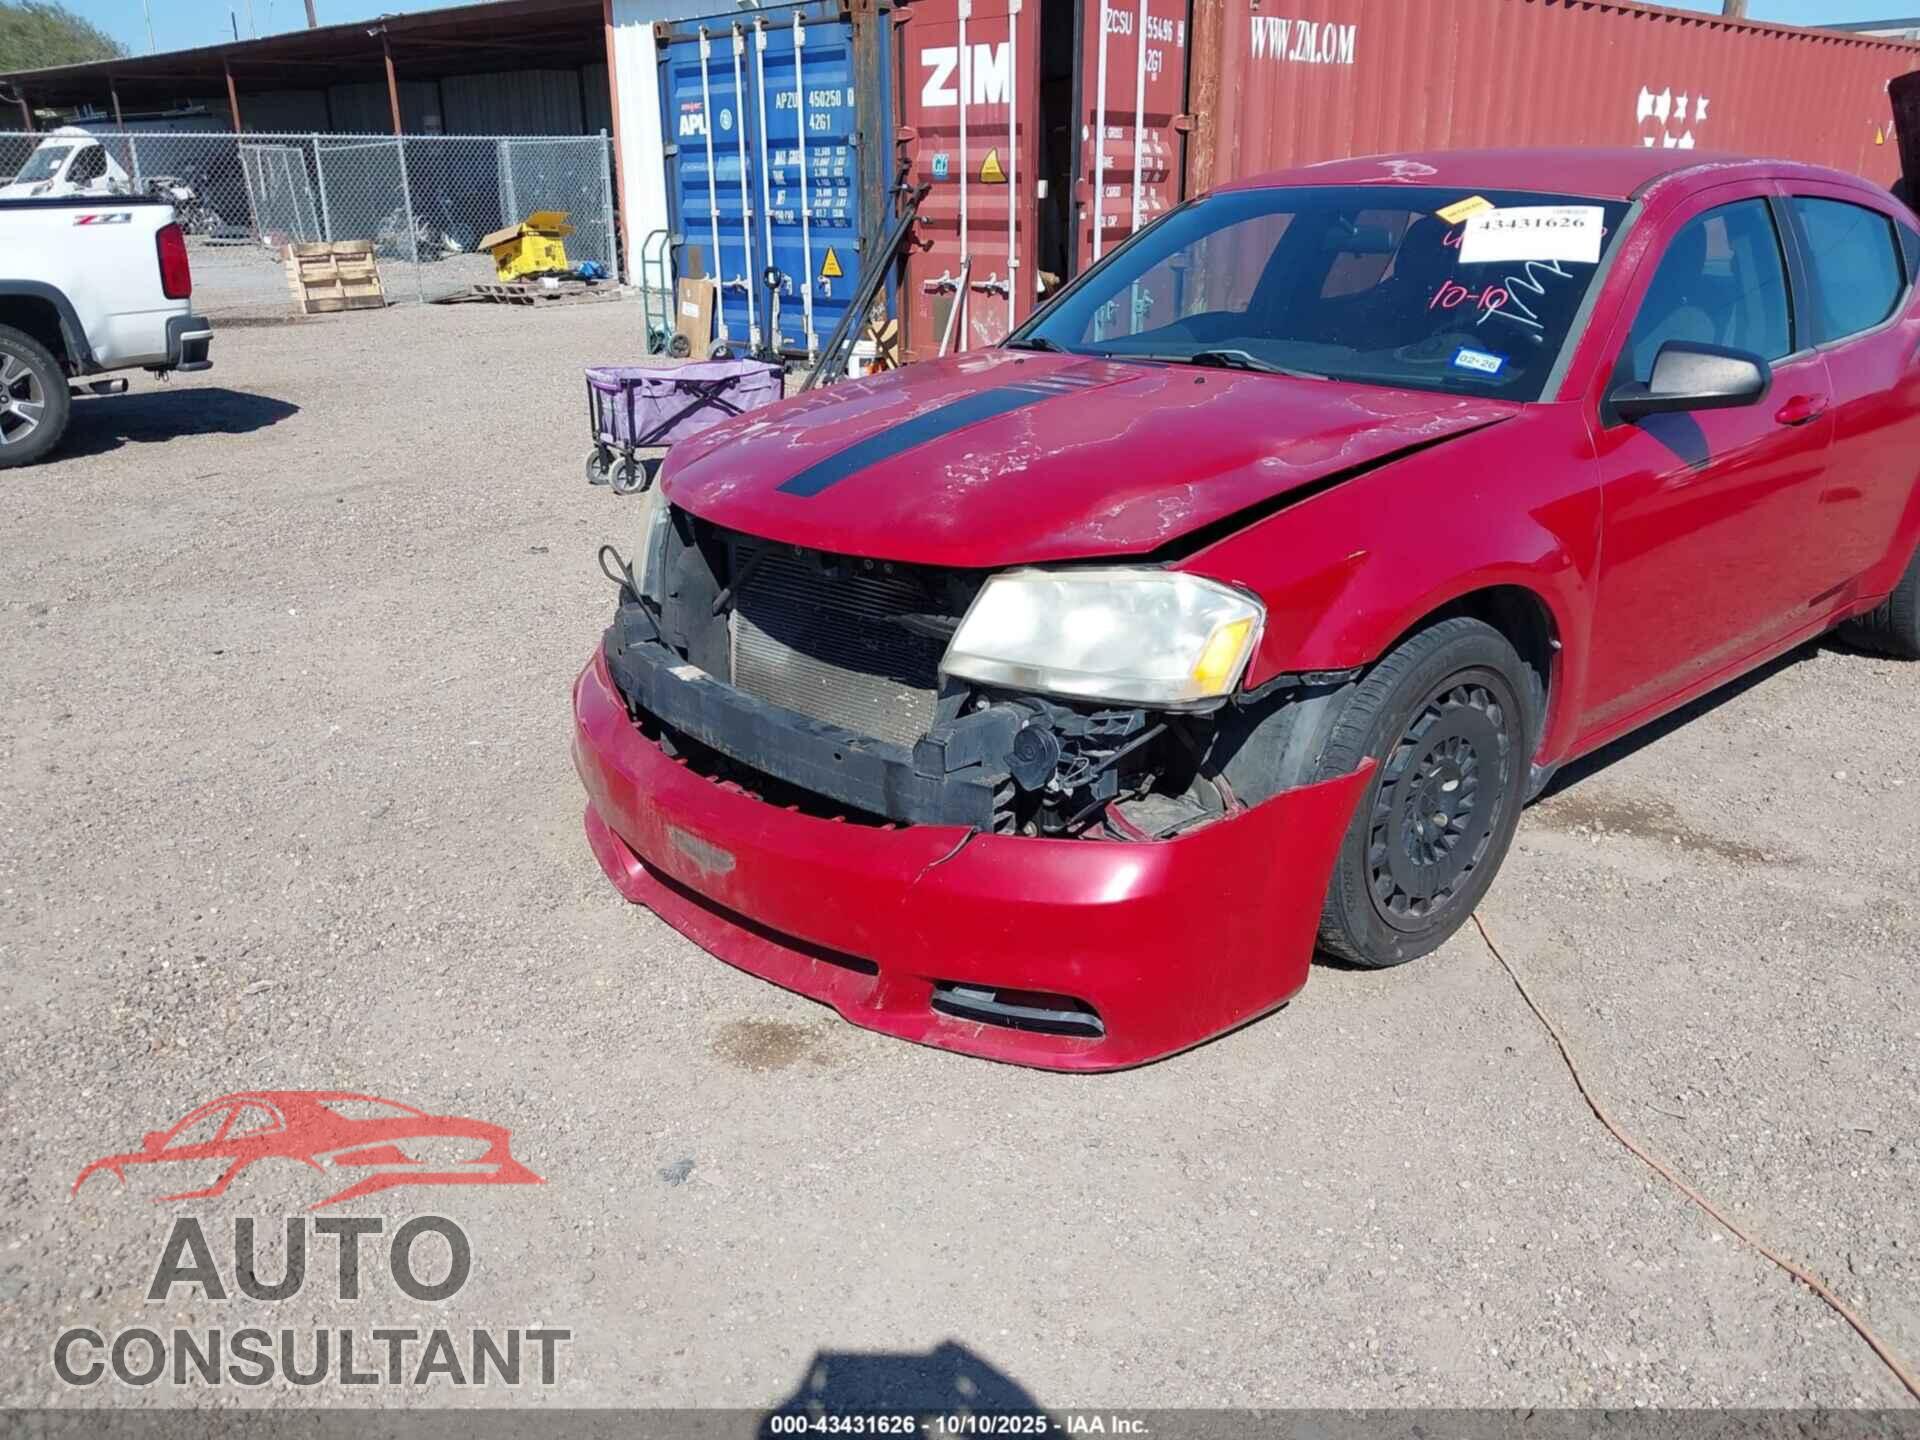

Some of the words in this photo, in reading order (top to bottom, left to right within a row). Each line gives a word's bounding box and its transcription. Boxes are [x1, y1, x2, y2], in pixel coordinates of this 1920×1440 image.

[1146, 15, 1174, 42] 55496
[1145, 49, 1162, 73] 2G1
[921, 42, 1012, 107] ZIM
[775, 92, 801, 109] APZU
[808, 89, 841, 108] 450250
[679, 113, 708, 136] APL
[1480, 217, 1585, 231] 43431626
[1459, 354, 1497, 370] 02-26
